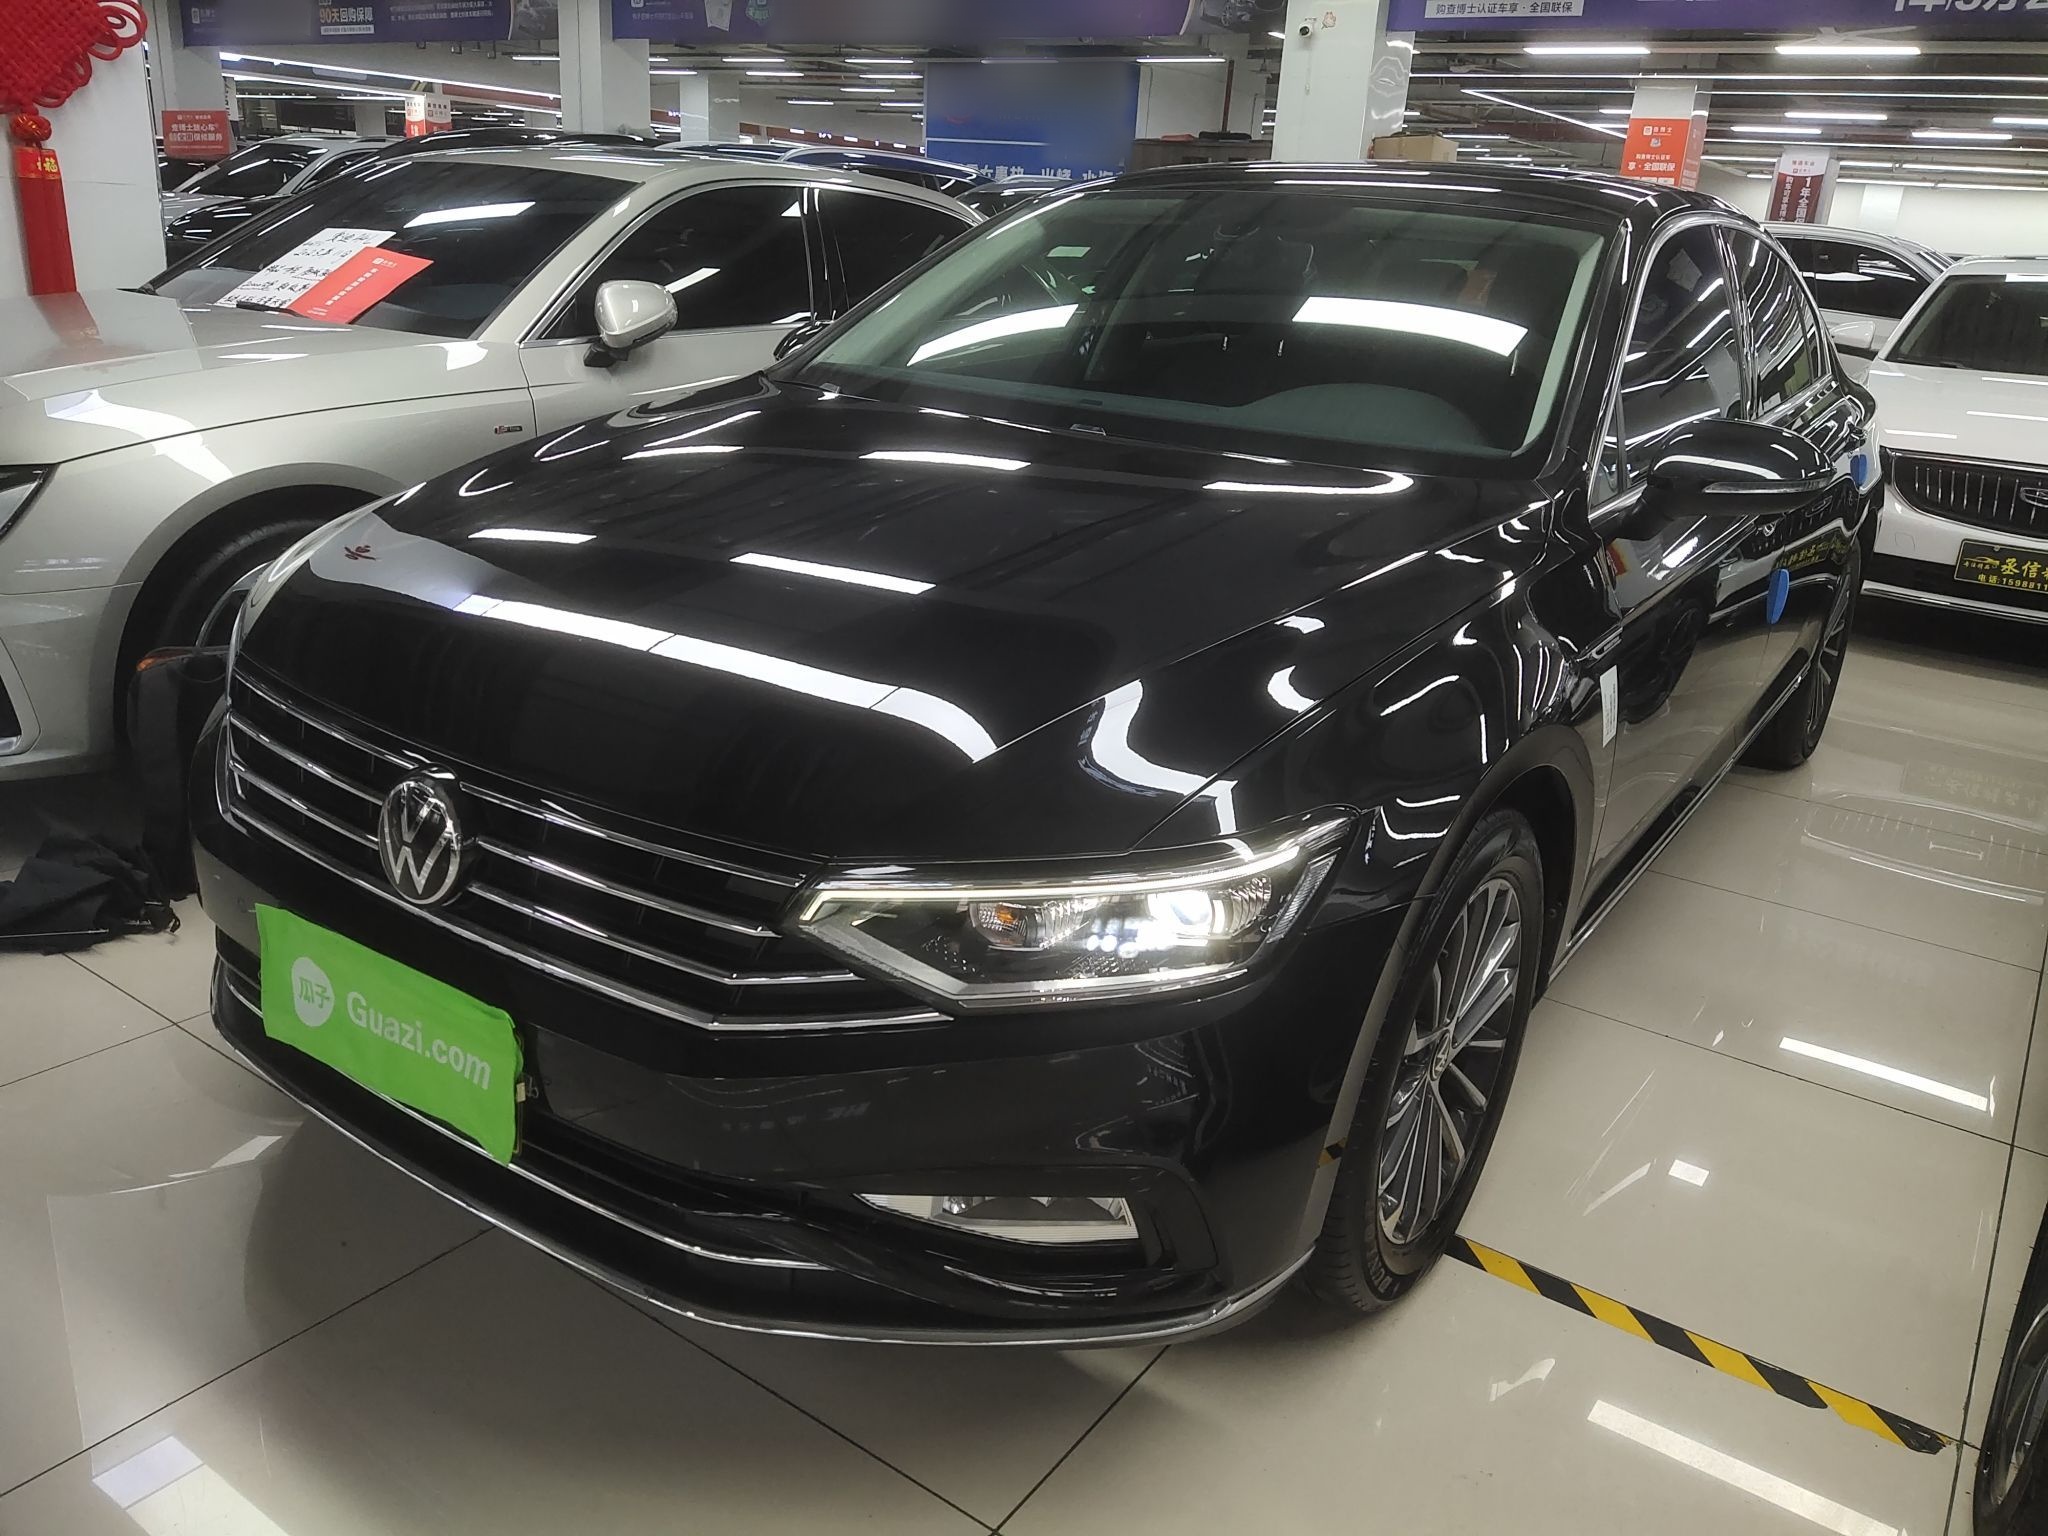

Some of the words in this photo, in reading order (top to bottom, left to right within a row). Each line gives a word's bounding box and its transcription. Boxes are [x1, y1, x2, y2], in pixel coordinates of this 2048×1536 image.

[319, 7, 374, 23] 90天回购保障
[298, 976, 330, 1009] 瓜子
[347, 991, 492, 1090] Guazi.com
